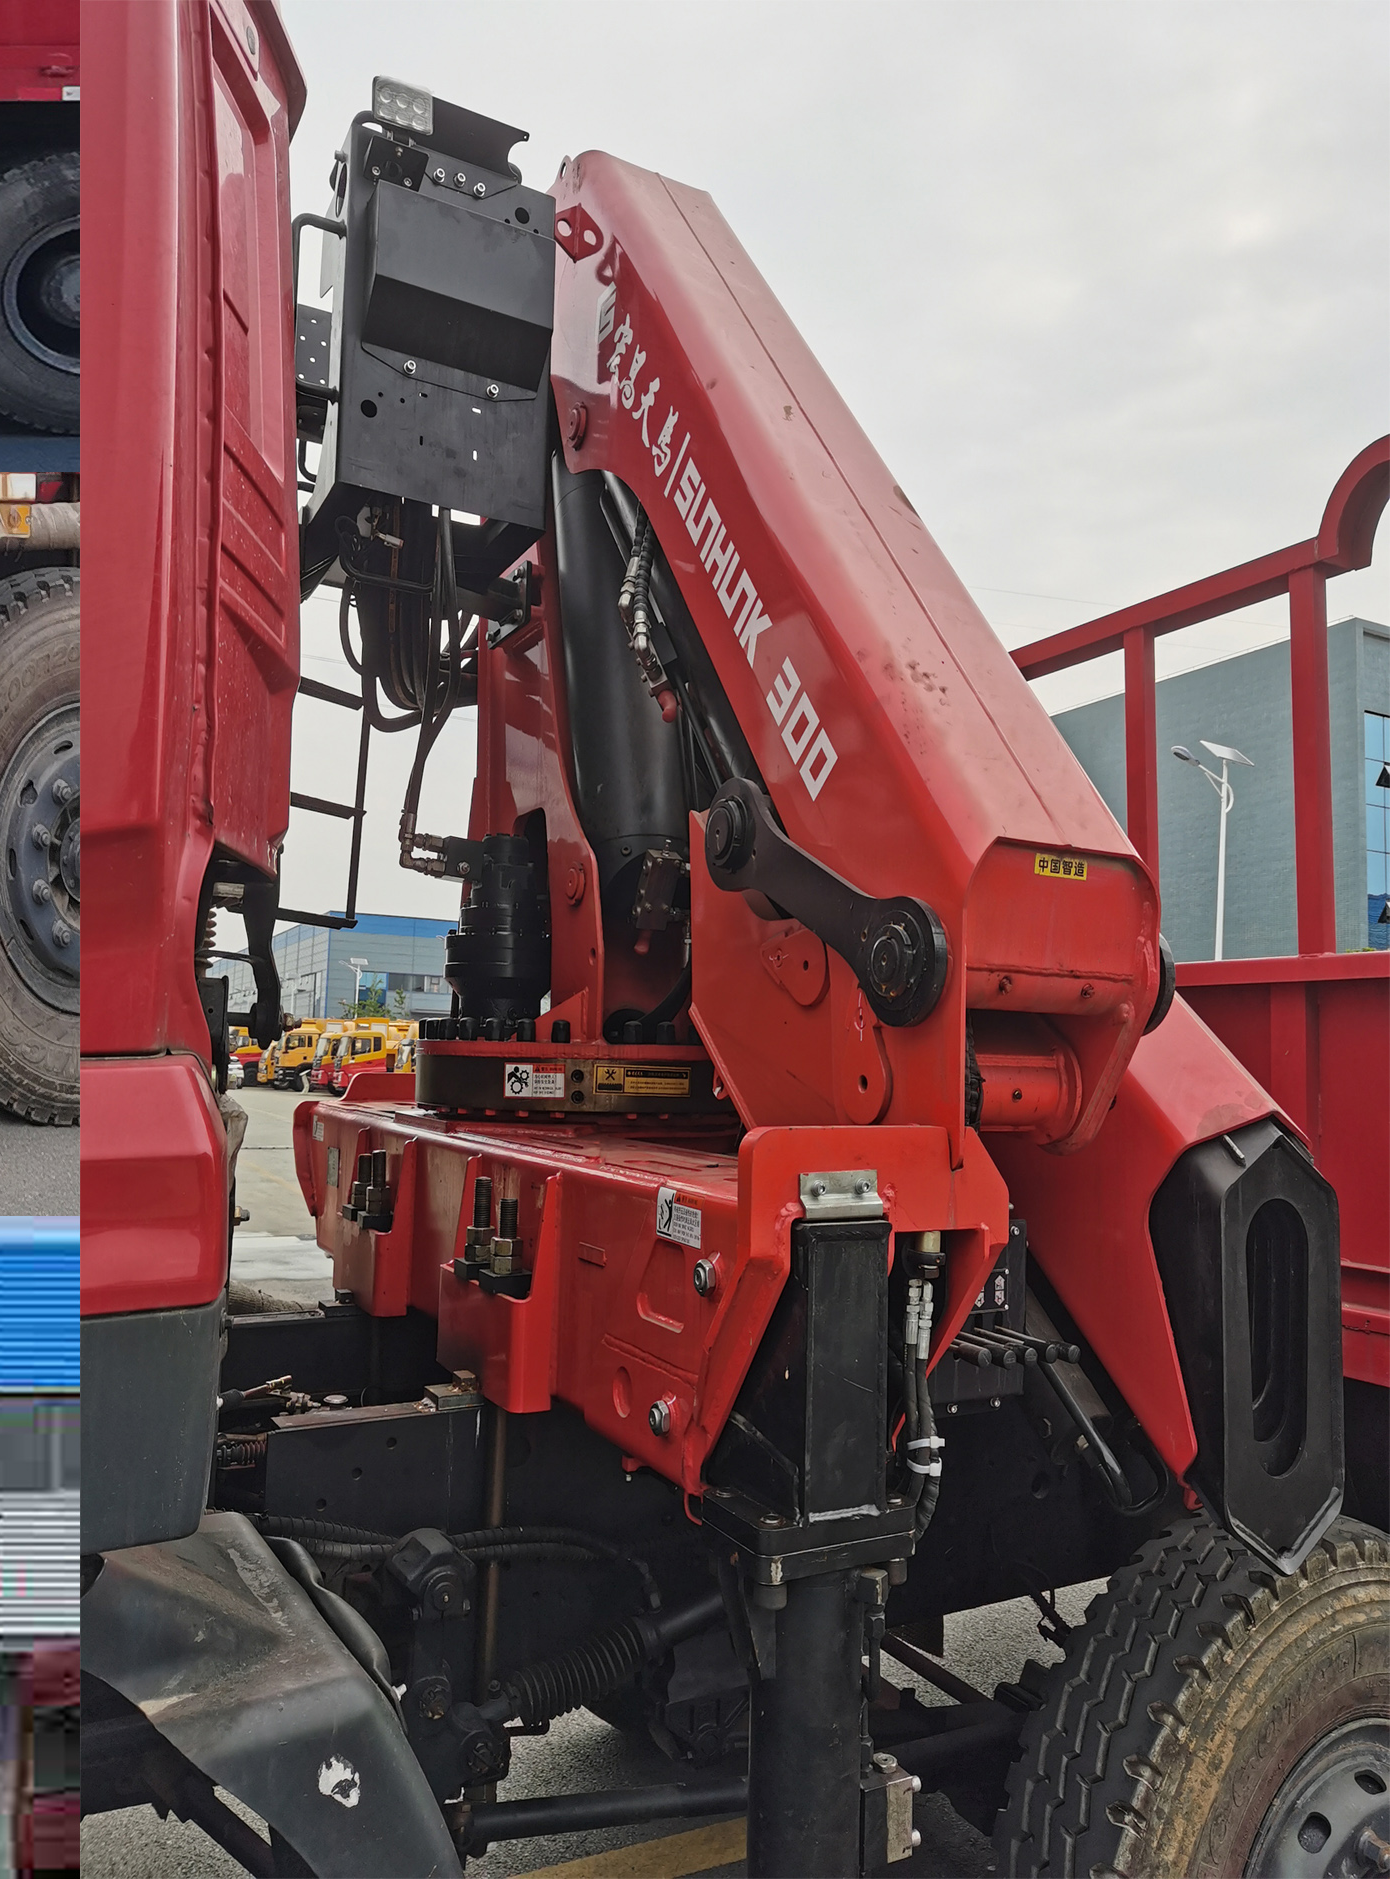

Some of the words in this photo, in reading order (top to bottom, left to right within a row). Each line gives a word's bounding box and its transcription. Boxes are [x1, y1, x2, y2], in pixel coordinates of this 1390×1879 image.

[766, 656, 838, 802] 300
[1038, 857, 1085, 877] 中国智造
